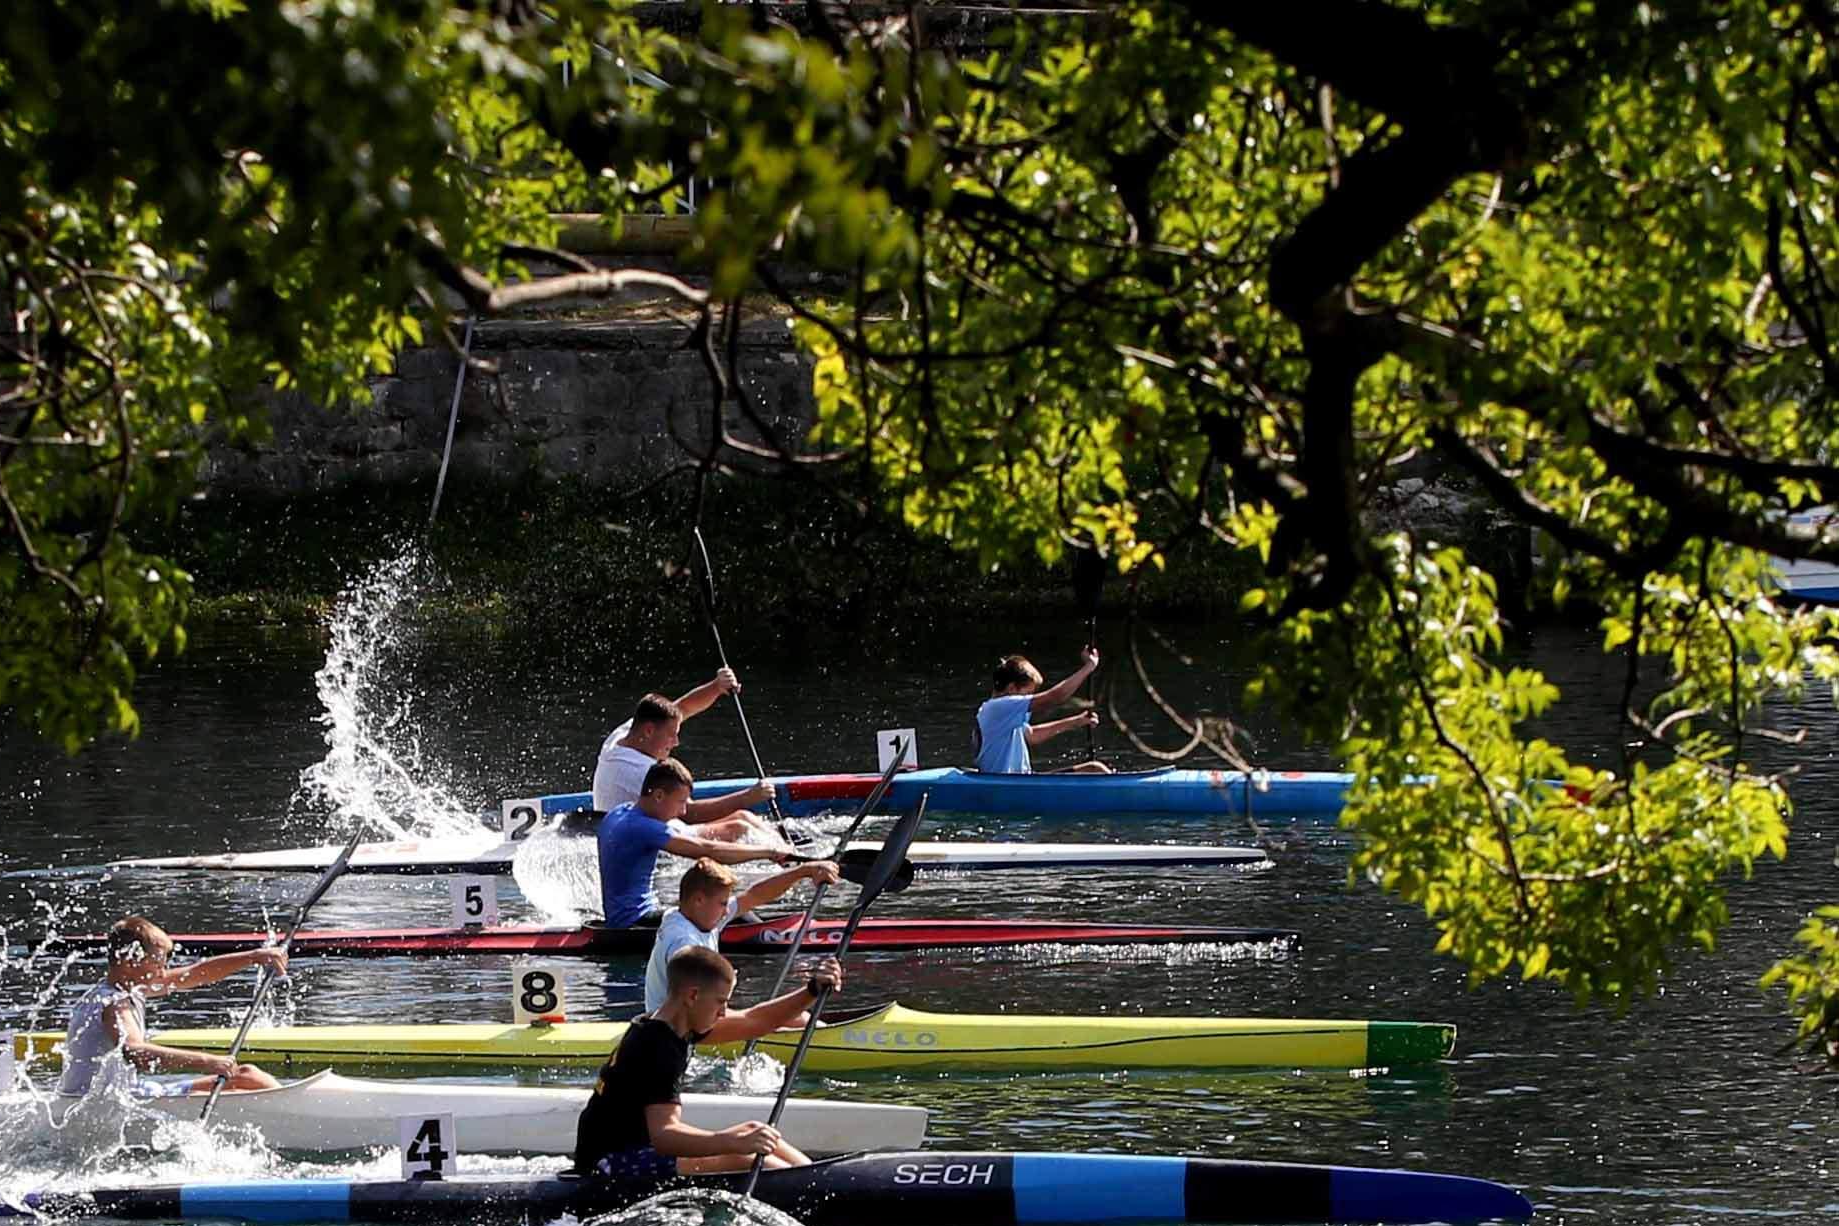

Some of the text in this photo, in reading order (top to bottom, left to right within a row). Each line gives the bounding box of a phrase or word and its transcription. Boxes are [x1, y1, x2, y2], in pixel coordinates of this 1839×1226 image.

[888, 735, 901, 756] 1
[510, 806, 537, 841] 2
[465, 885, 483, 916] 5
[521, 971, 558, 1014] 8
[843, 1028, 937, 1047] NELO
[406, 1119, 449, 1171] 4
[893, 1163, 994, 1185] SECH
